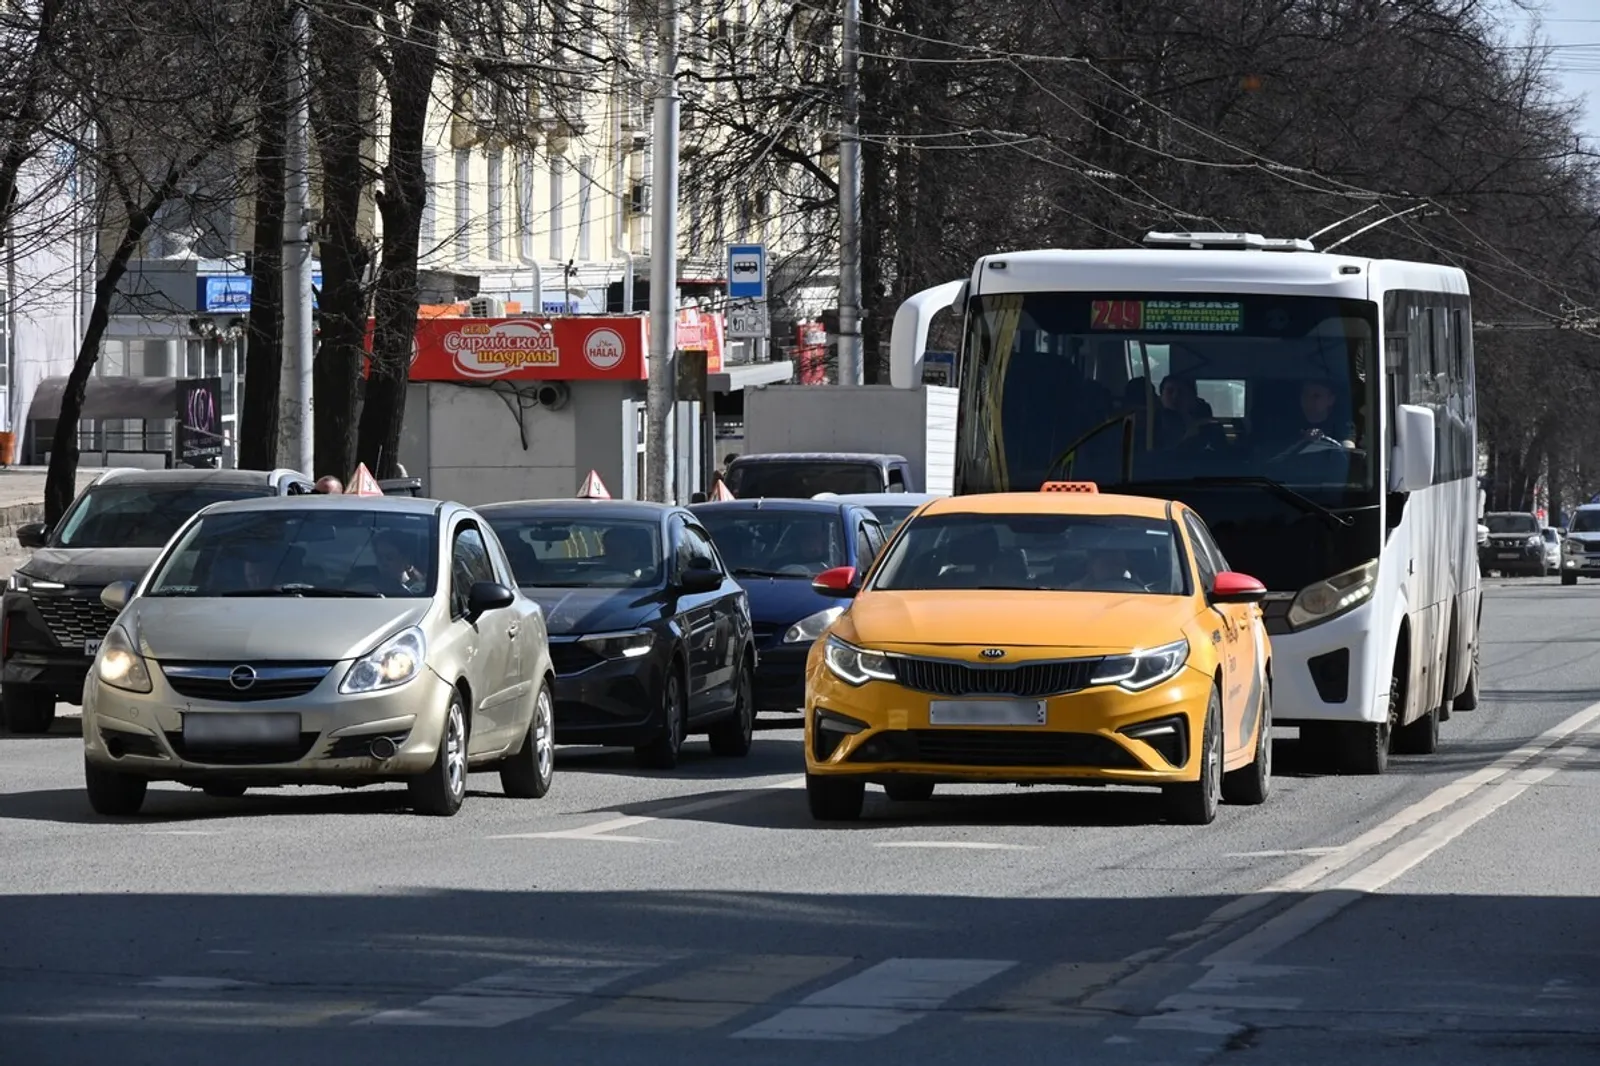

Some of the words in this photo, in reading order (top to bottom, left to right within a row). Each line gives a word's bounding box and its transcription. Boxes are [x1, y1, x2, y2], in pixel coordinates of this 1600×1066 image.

[1091, 300, 1140, 329] 249
[1146, 321, 1239, 331] БГУ-ТЕЛЕЦЕНТР
[447, 331, 550, 353] Сирийской
[478, 350, 557, 367] шаурмы
[589, 348, 619, 358] HALAL
[984, 649, 1002, 657] KIA
